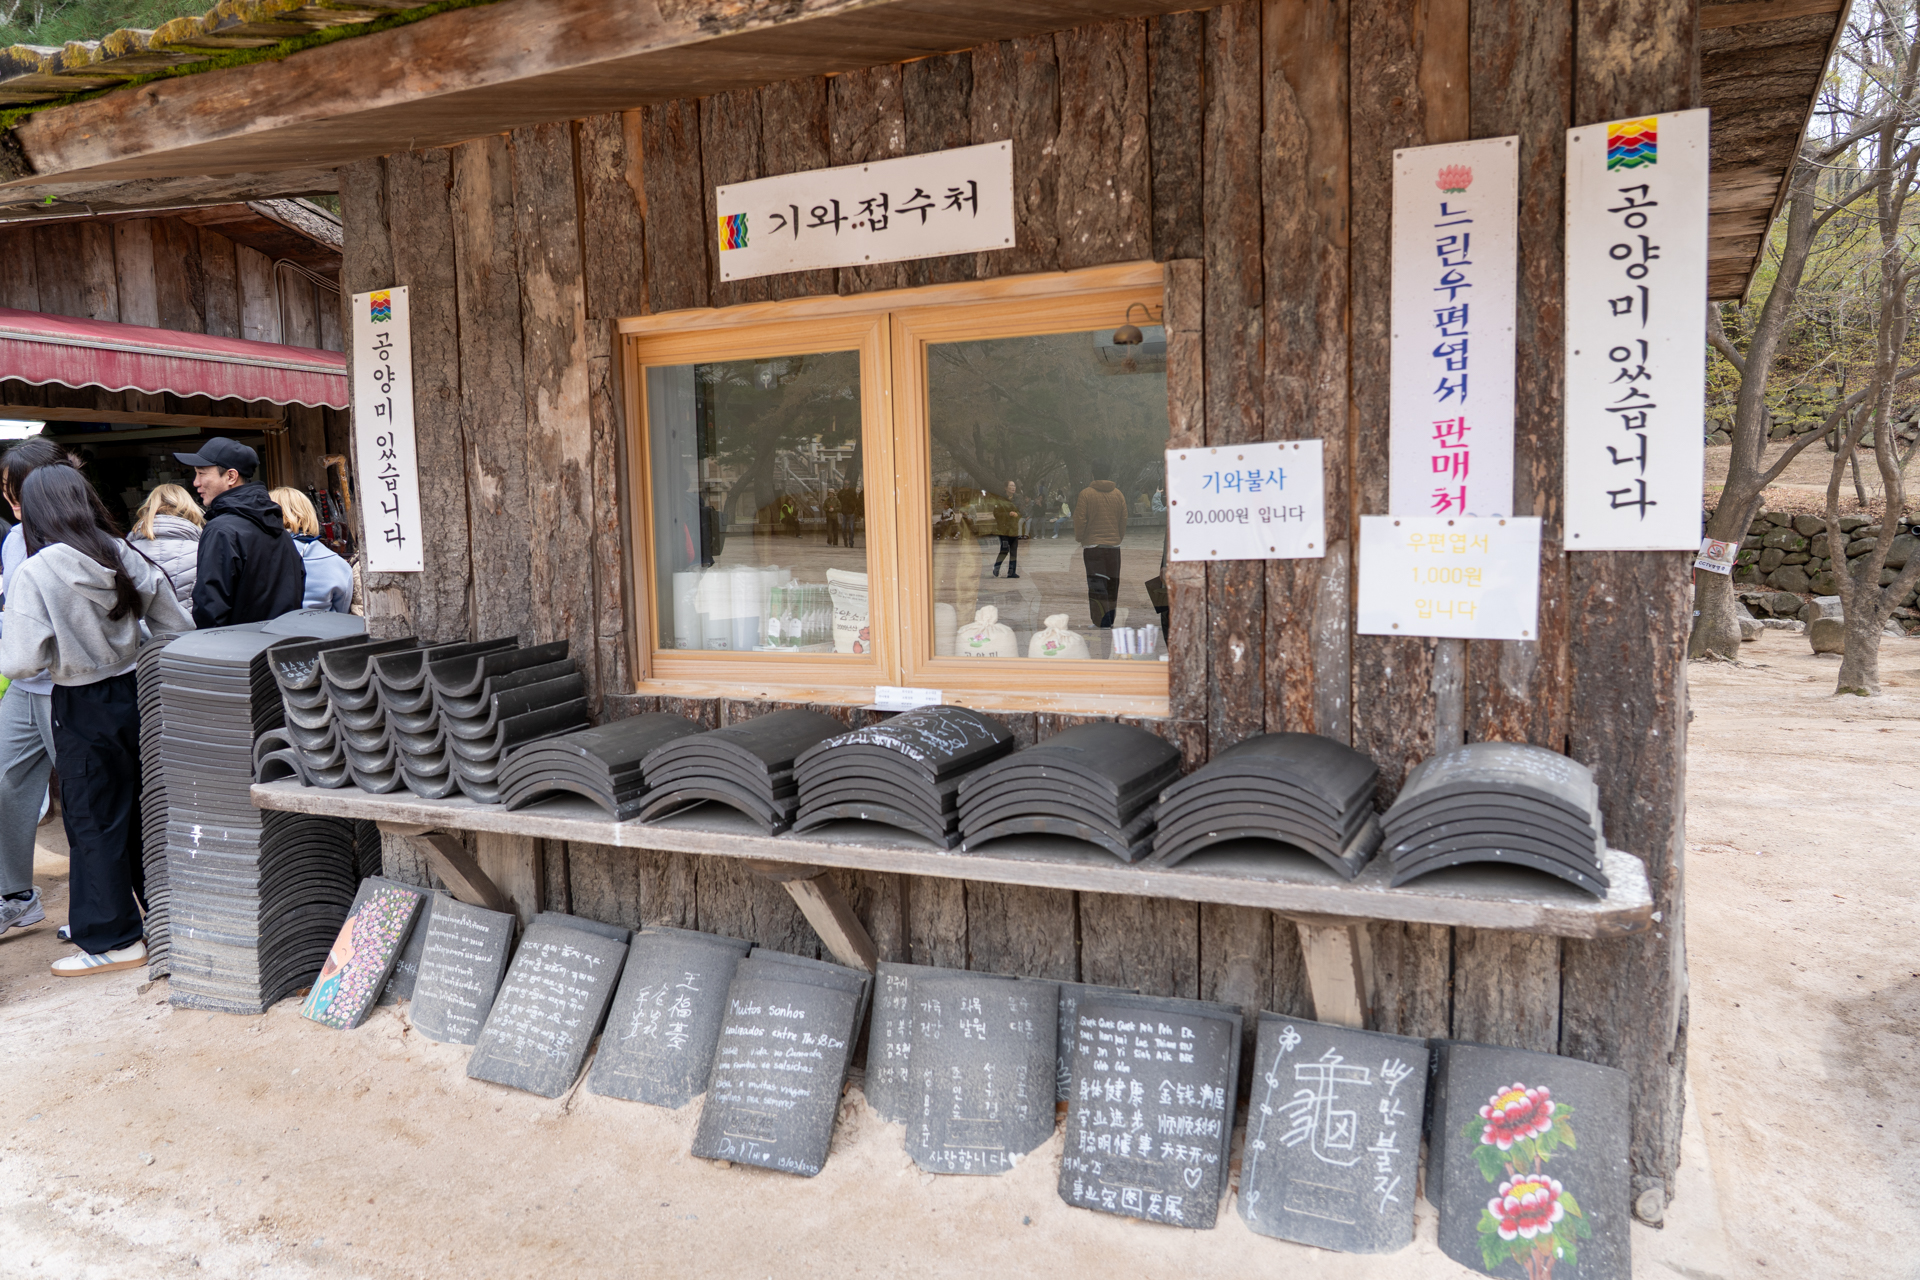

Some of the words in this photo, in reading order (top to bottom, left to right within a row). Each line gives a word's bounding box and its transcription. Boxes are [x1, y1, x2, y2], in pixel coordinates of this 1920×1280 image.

[1607, 183, 1661, 330] 공양미
[371, 331, 396, 423] 공양미
[1604, 338, 1659, 522] 있습니다
[1430, 415, 1472, 517] 판매처
[375, 431, 406, 552] 있습니다
[1201, 467, 1289, 494] 기와불사
[1184, 508, 1250, 526] 20,000원
[1257, 503, 1306, 525] 입니다
[1405, 531, 1491, 556] 우편엽서
[1409, 565, 1483, 589] 1,000원
[1414, 597, 1478, 621] 입니다
[729, 998, 762, 1017] Muitos
[920, 999, 941, 1017] 가족
[771, 1026, 798, 1041] entre
[920, 1019, 944, 1040] 건강
[959, 1017, 987, 1041] 발원
[773, 1060, 814, 1074] salsichas
[1078, 1077, 1145, 1108] 身体健康
[1077, 1106, 1144, 1134] 学业进步
[1157, 1113, 1222, 1139] 顺顺利利
[929, 1148, 1008, 1170] 사랑합니다
[1078, 1129, 1153, 1158] 聪明懂事
[1159, 1142, 1219, 1165] 天天开心
